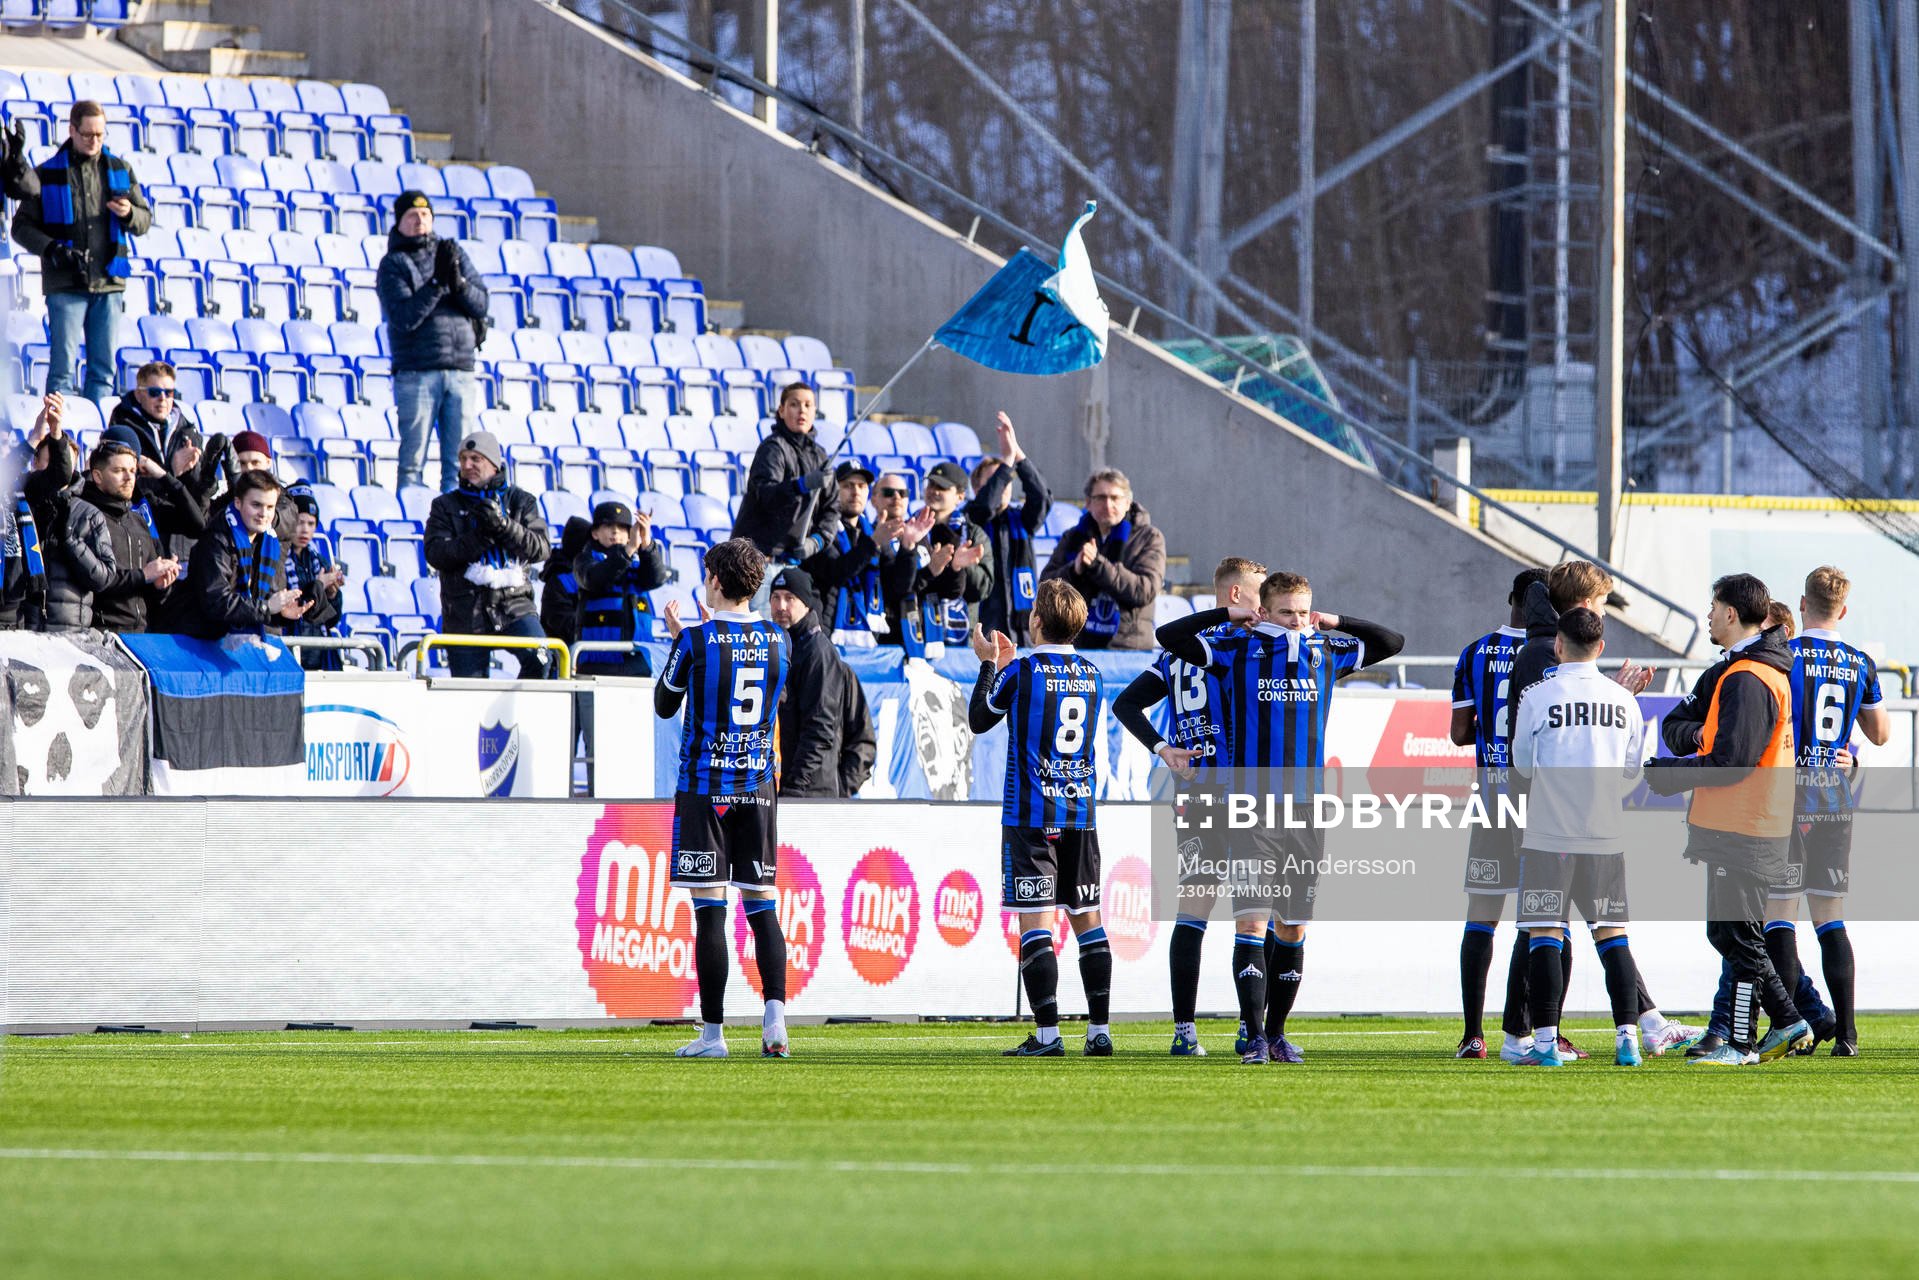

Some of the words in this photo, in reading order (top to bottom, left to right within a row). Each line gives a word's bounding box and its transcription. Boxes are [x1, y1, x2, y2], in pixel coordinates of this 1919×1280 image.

[708, 632, 748, 645] ÅRSTA
[767, 633, 784, 643] TAK
[732, 649, 769, 662] ROCHE
[1477, 644, 1515, 655] ÅRSTA
[1793, 647, 1833, 659] ÅRSTA
[1846, 653, 1866, 667] TAK
[1034, 663, 1072, 674] ÅRSTA
[1806, 664, 1858, 682] MATHISEN
[1046, 679, 1097, 692] STENSSON
[1169, 658, 1207, 715] 13
[1257, 679, 1288, 690] BYGG
[732, 667, 765, 726] 5
[1257, 690, 1319, 702] CONSTRUCT
[1548, 702, 1626, 729] SIRIUS
[1815, 683, 1846, 741] 6
[1055, 696, 1087, 754] 8
[720, 730, 766, 743] NORDIC
[481, 737, 499, 754] IFK
[707, 738, 772, 753] WELLNESS
[304, 742, 371, 782] ANSPORT
[710, 753, 767, 770] inkClub
[1044, 758, 1085, 770] NORDIC
[1034, 765, 1095, 779] WELLNESS
[1487, 768, 1509, 784] ink
[1041, 780, 1092, 799] inkClub
[711, 795, 731, 804] TEAM
[849, 925, 907, 959] MEGAPOL
[591, 922, 698, 980] MEGAPOL
[744, 933, 810, 971] MPOL
